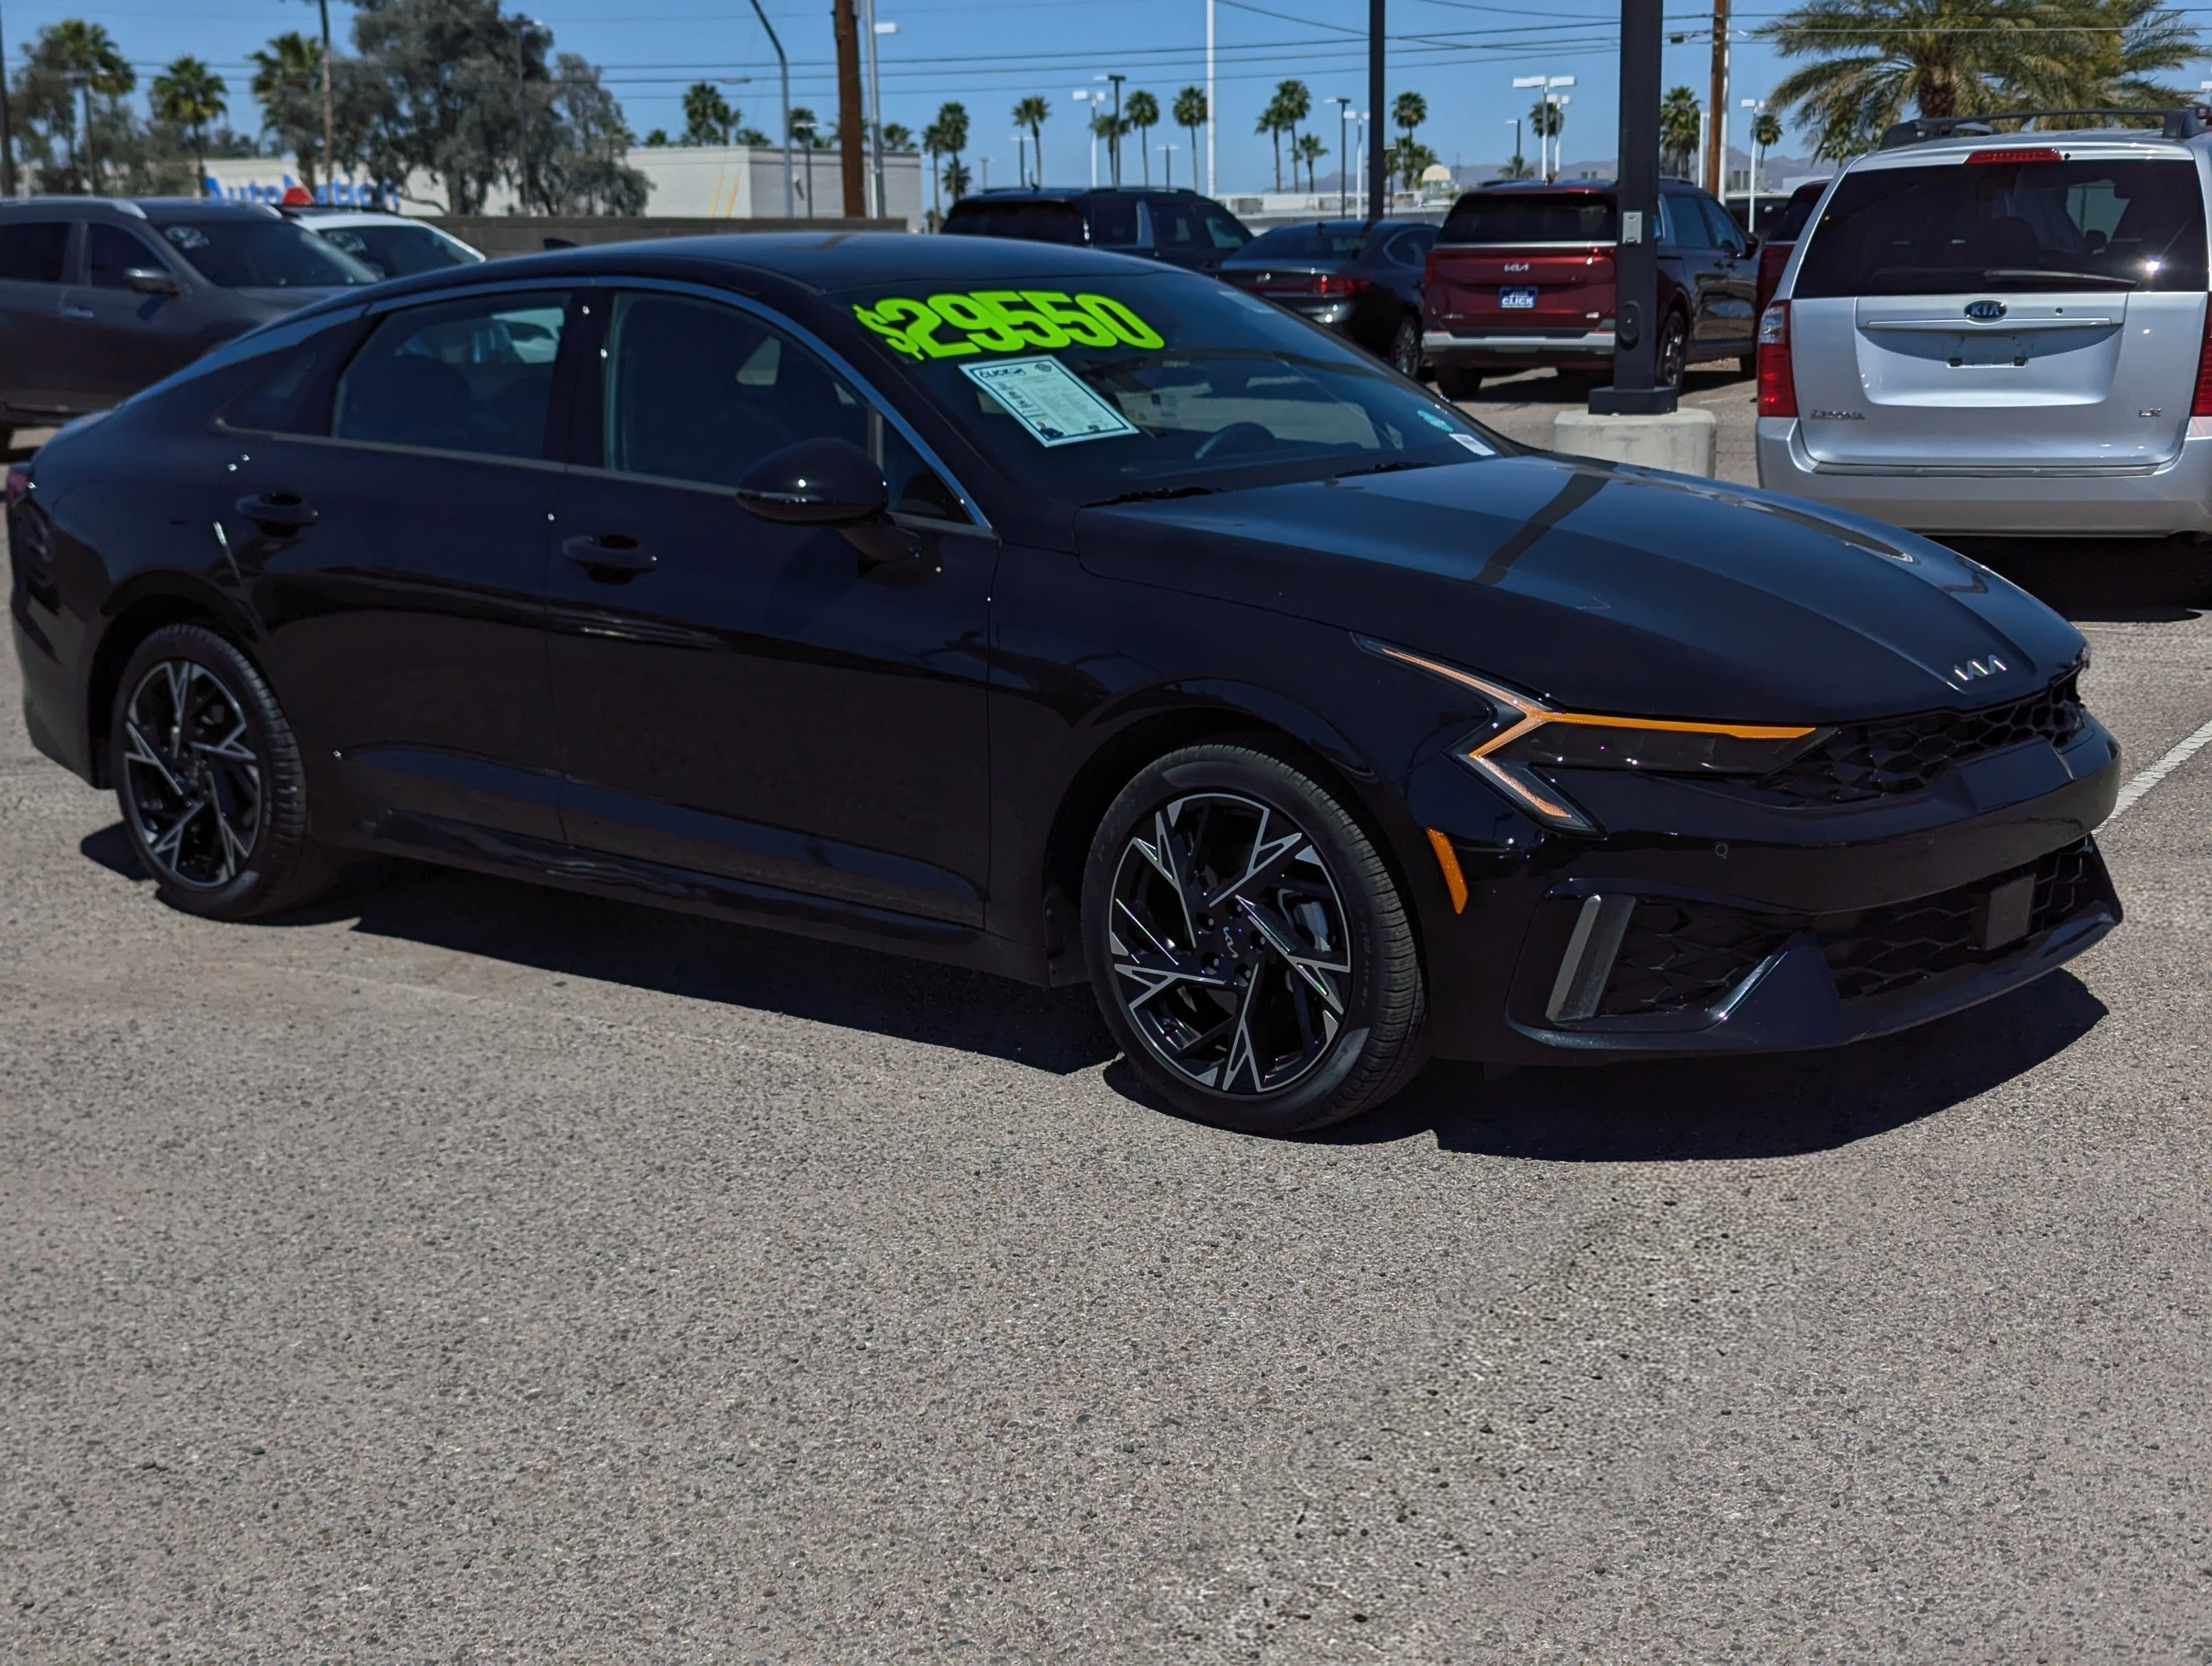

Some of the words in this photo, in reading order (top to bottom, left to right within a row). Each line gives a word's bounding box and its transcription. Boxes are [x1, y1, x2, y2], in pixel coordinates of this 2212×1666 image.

[1501, 296, 1533, 305] CLICK
[1971, 304, 2000, 316] KIA
[852, 290, 1165, 361] $29550
